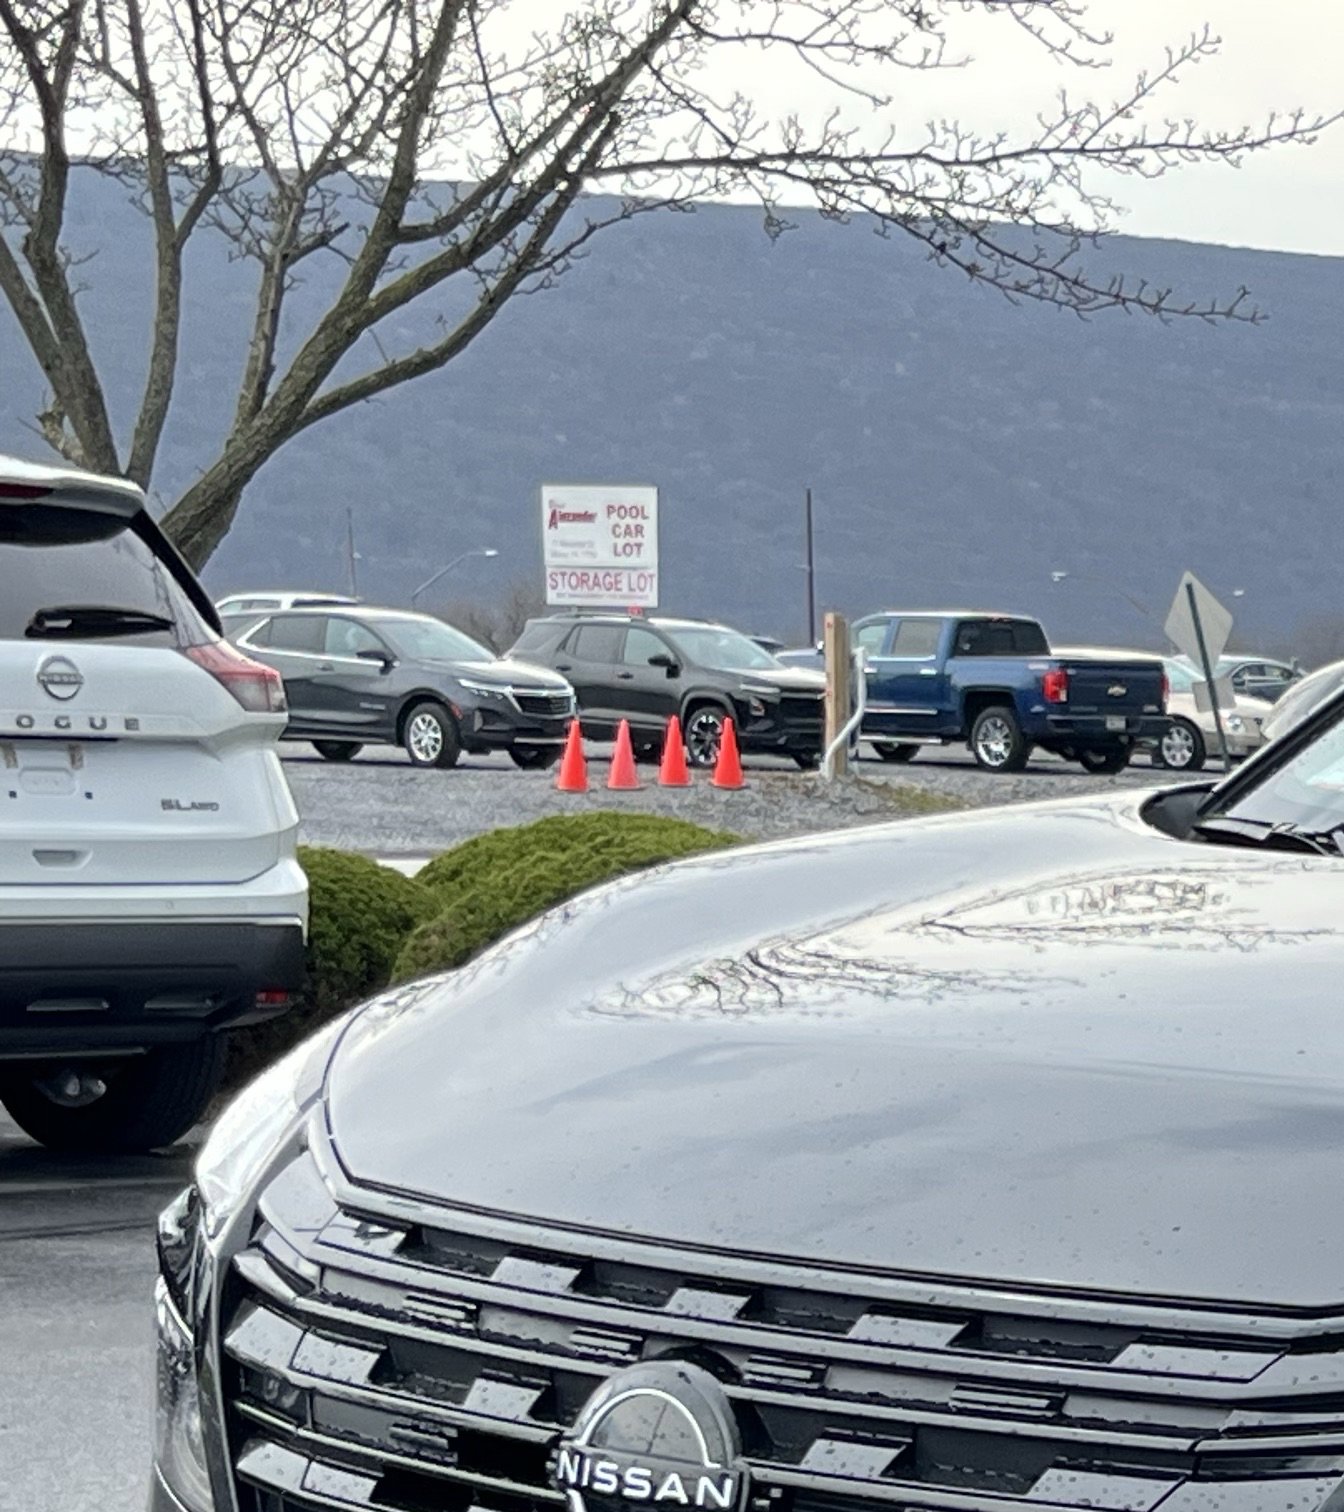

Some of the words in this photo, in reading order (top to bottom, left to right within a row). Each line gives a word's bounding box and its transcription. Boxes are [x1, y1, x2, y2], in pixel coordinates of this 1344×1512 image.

[607, 504, 650, 520] POOL
[612, 523, 645, 539] CAR
[613, 542, 644, 558] LOT
[549, 571, 623, 592] STORAGE
[628, 571, 656, 593] LOT
[556, 1450, 734, 1508] NISSAN
